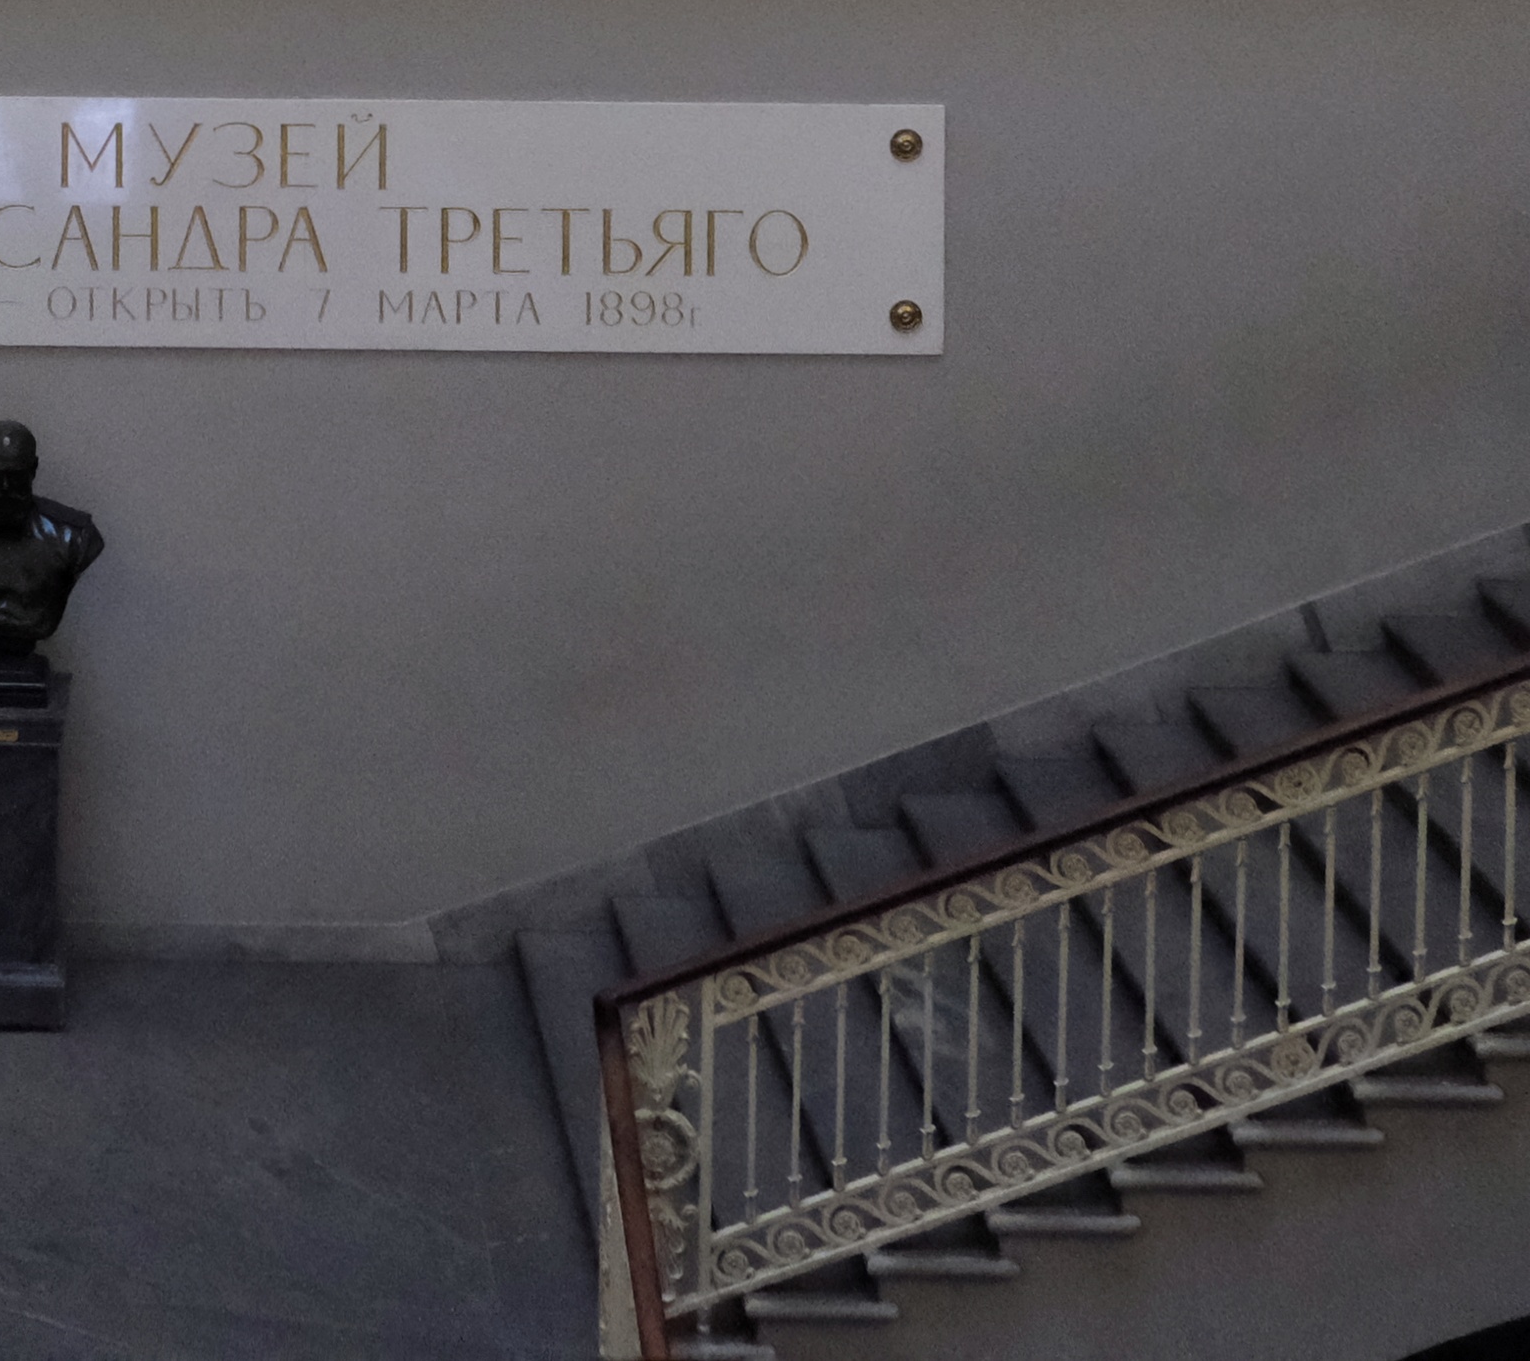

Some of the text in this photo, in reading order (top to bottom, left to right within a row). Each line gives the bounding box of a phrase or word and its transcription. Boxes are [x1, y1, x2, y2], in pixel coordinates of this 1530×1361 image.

[59, 111, 390, 192] МУЗЕЙ
[376, 205, 810, 278] ТРЕТЬЯГО
[310, 287, 332, 324] 7
[377, 288, 542, 326] МАРТА
